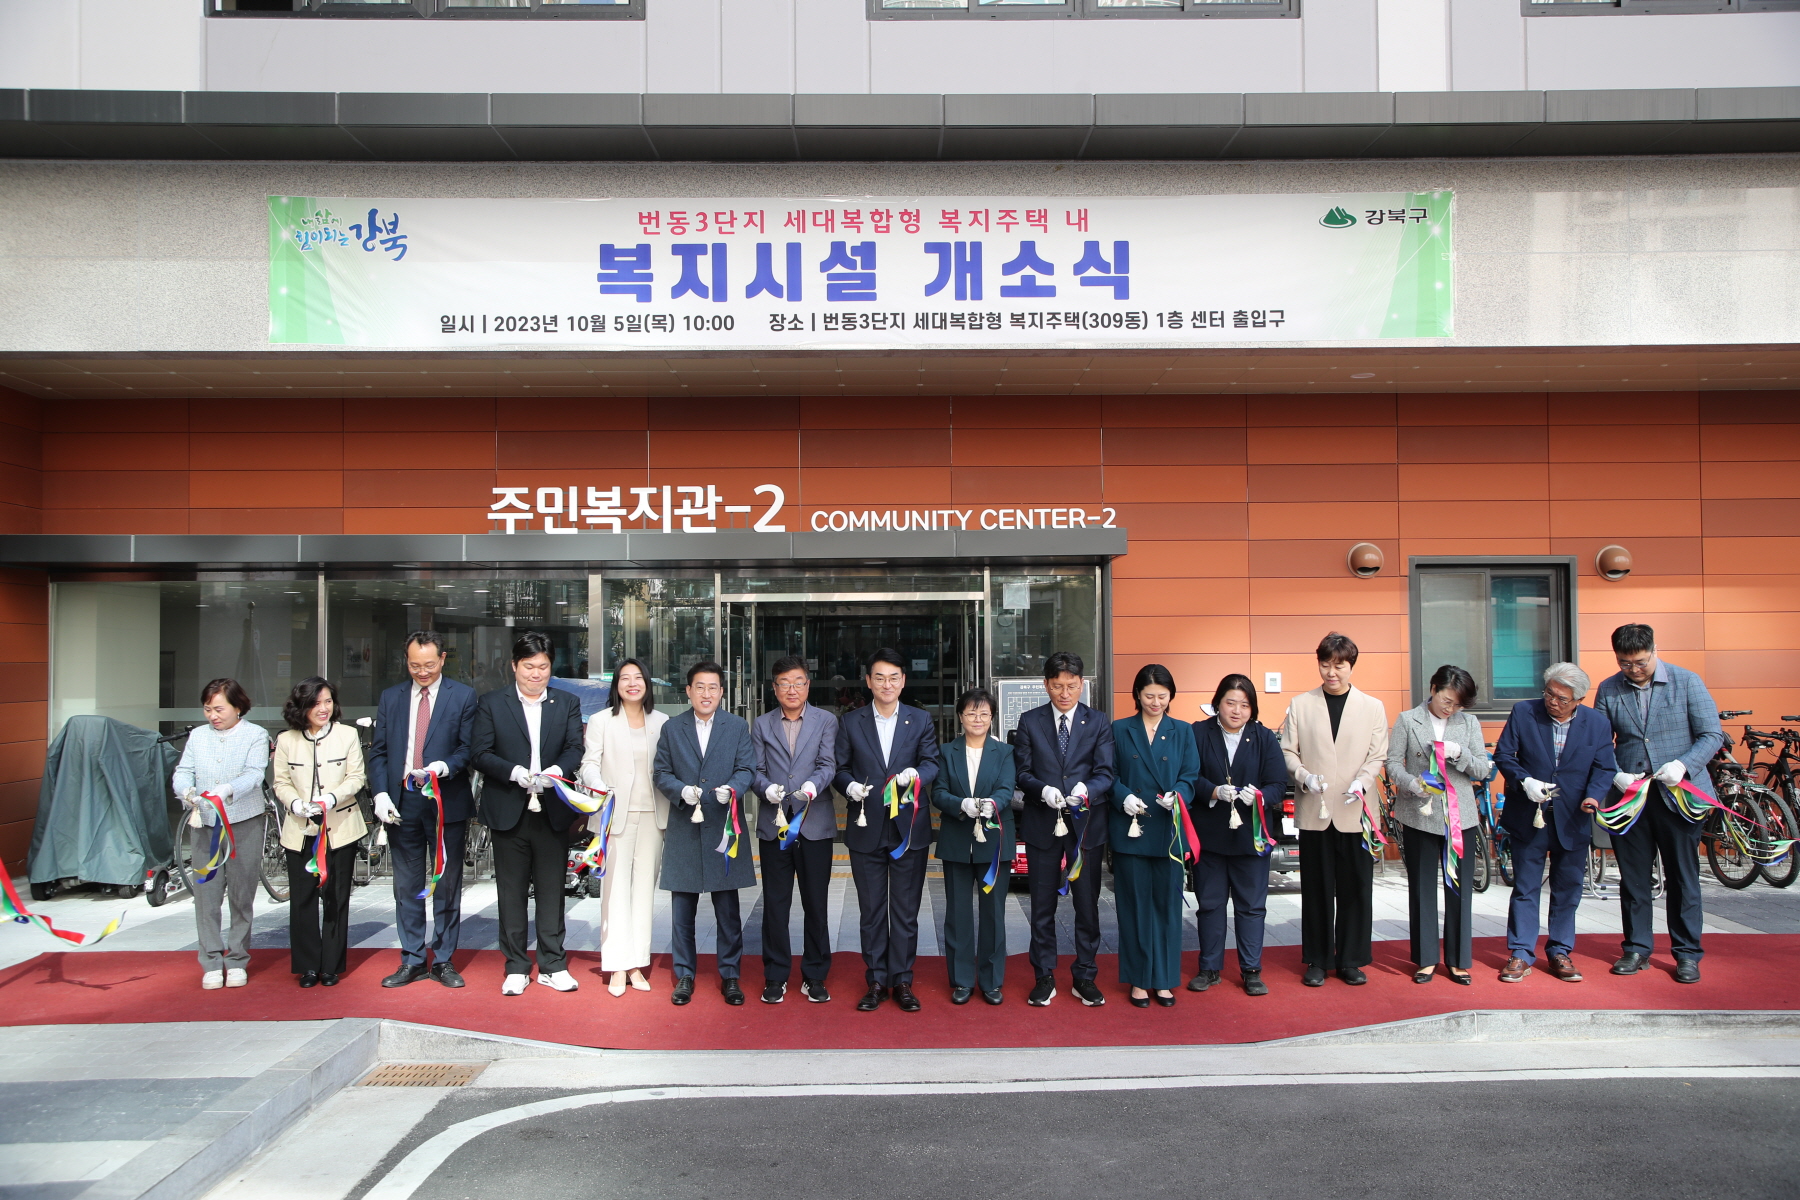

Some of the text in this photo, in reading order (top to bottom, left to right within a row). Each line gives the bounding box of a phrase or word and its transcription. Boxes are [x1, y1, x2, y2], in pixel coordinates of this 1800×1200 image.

[638, 208, 1089, 236] 번동3단지 세대복합형 복지주택 내
[1364, 207, 1429, 226] 강북구
[348, 208, 408, 261] 강북
[597, 240, 1130, 303] 복지시설 개소식
[440, 314, 475, 333] 일시
[494, 314, 559, 333] 2023년
[567, 314, 606, 333] 10월
[614, 313, 675, 334] 5일(목)
[683, 315, 735, 332] 10:00
[769, 313, 804, 332] 장소
[823, 312, 905, 331] 번동3단지
[913, 312, 1002, 330] 세대복합형
[1009, 310, 1148, 331] 복지주택(309동)
[1156, 310, 1184, 329] 1층
[1190, 310, 1225, 329] 센터
[1232, 309, 1285, 329] 출입구
[487, 484, 786, 535] 주민복지관-2
[811, 507, 1117, 532] COMMUNITY CENTER-2
